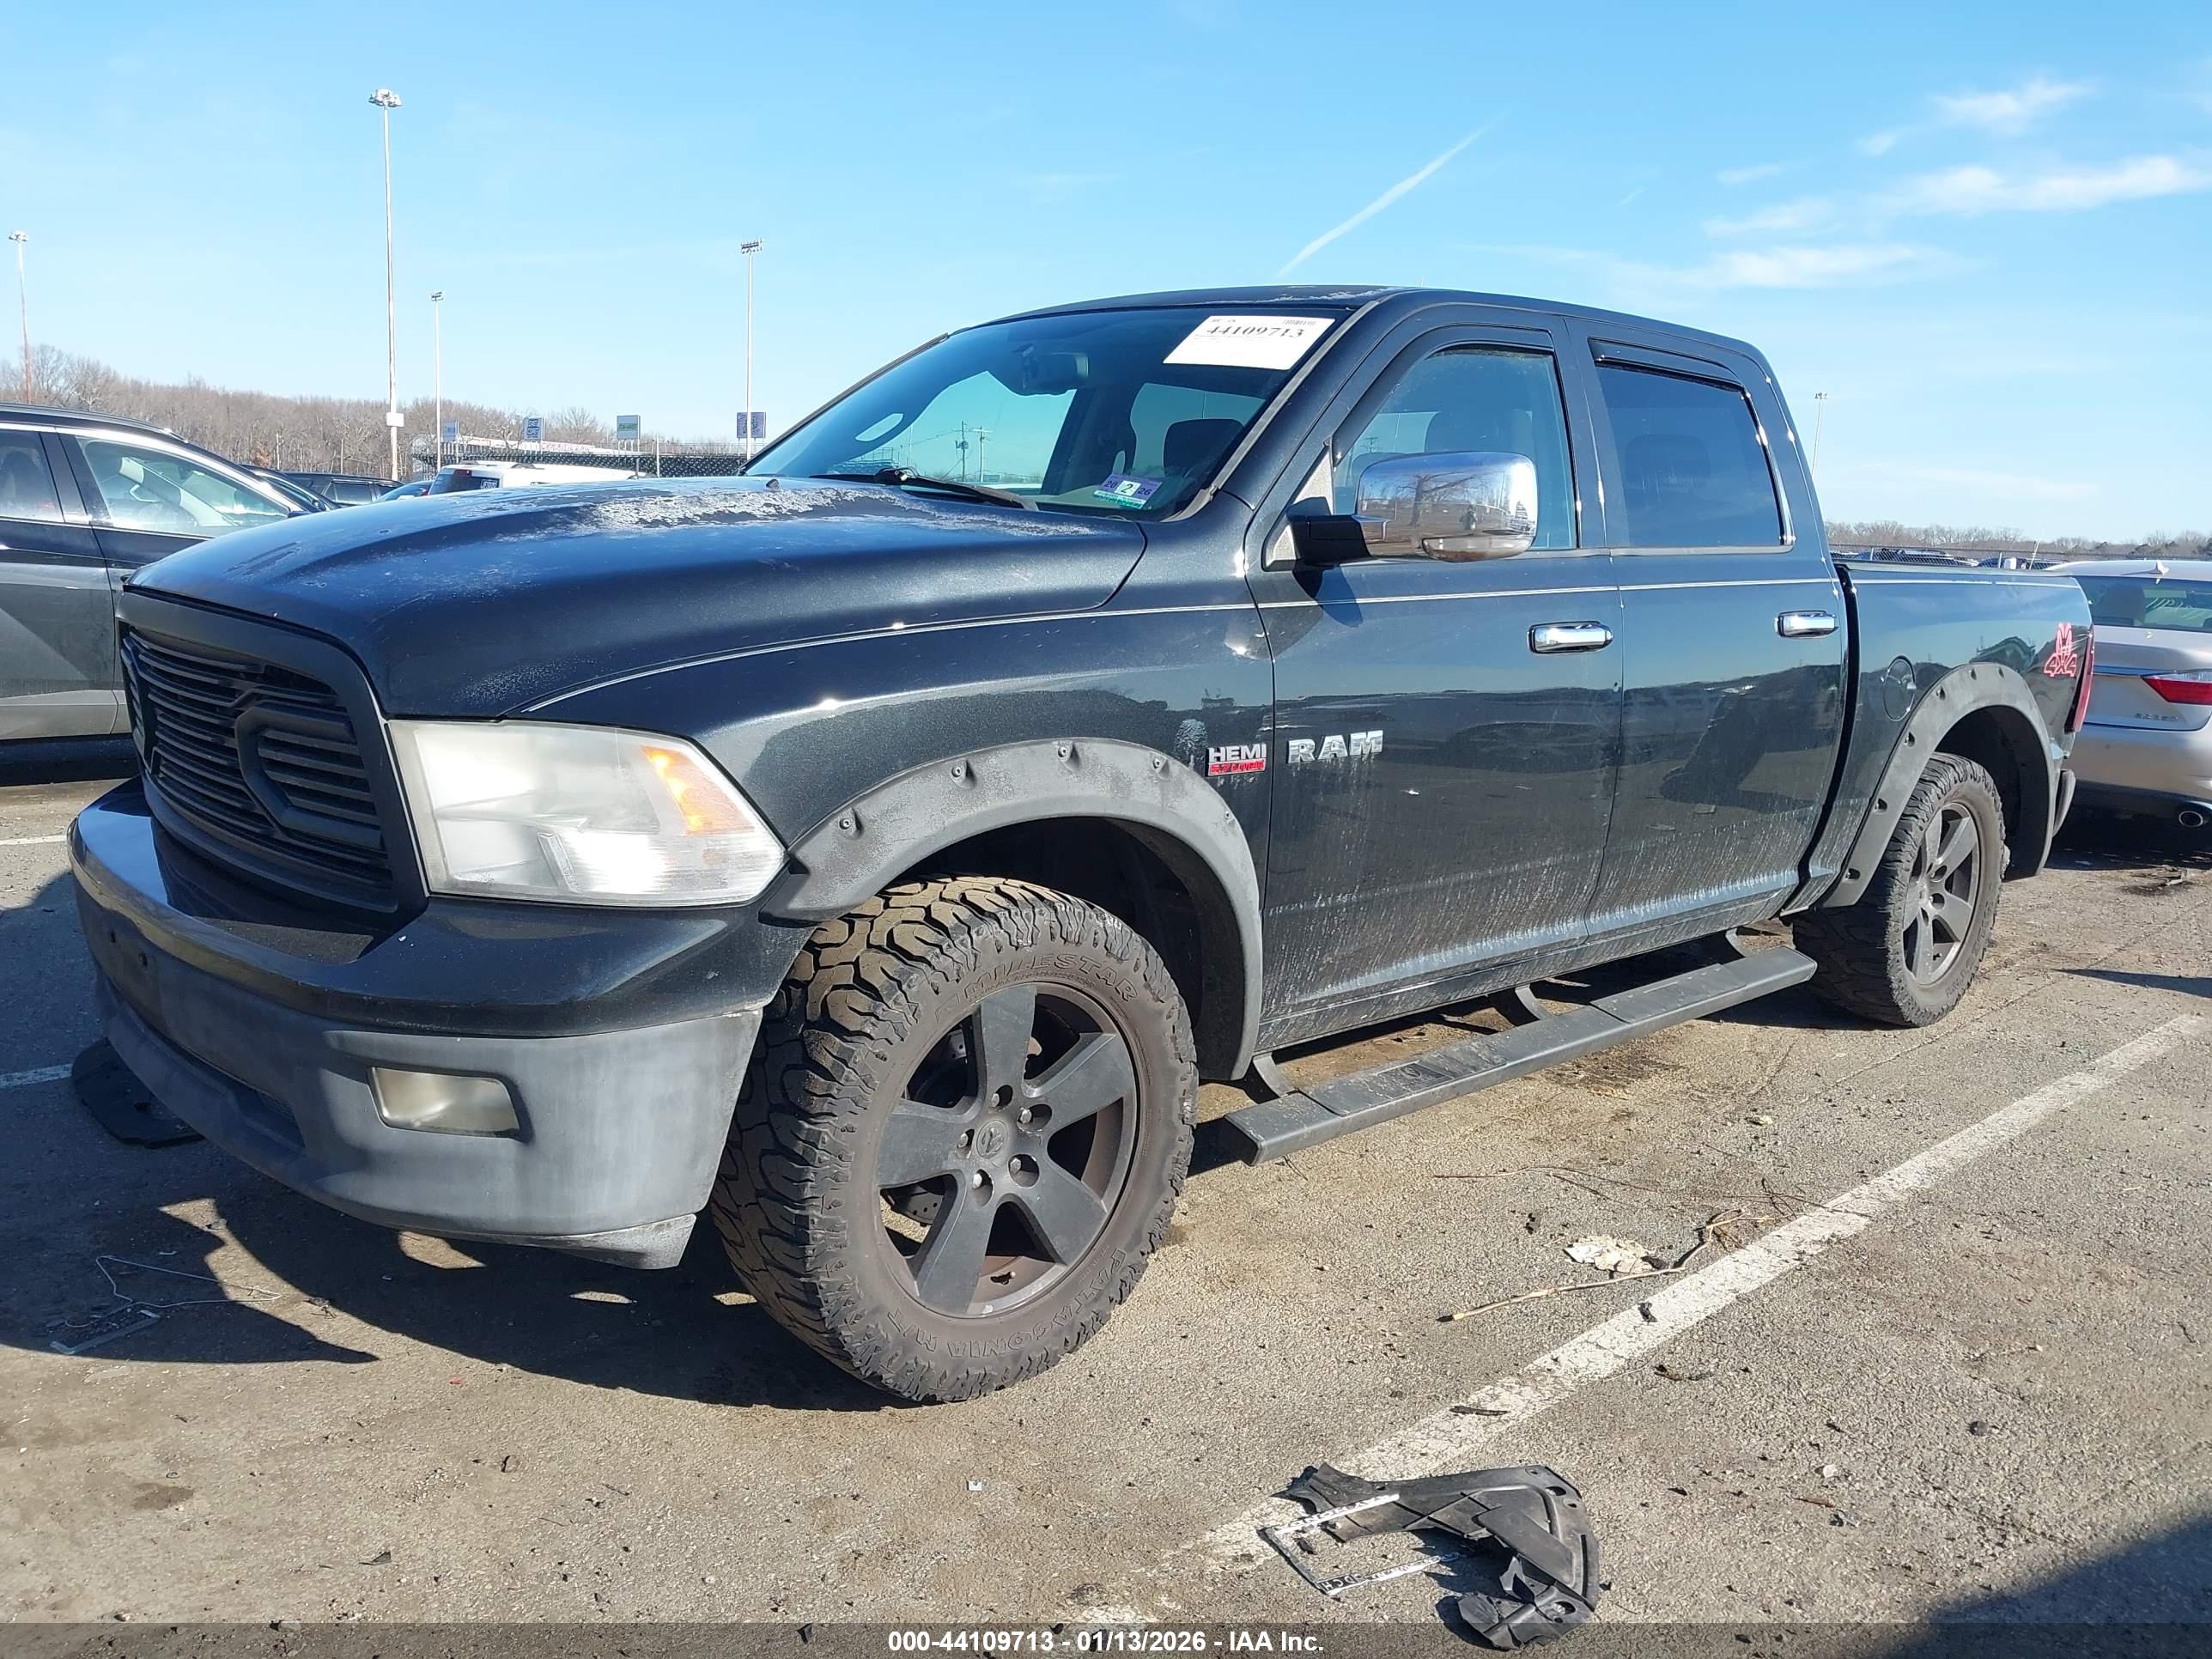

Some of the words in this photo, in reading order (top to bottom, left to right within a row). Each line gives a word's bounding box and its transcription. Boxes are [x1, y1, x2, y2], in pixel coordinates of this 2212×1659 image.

[1206, 325, 1305, 338] 44109713
[1121, 483, 1133, 494] 2
[1207, 743, 1267, 763] HEMI
[1287, 730, 1383, 763] RAM
[963, 953, 1139, 1002] MILESTAR
[947, 1247, 1127, 1358] PATAGONIA
